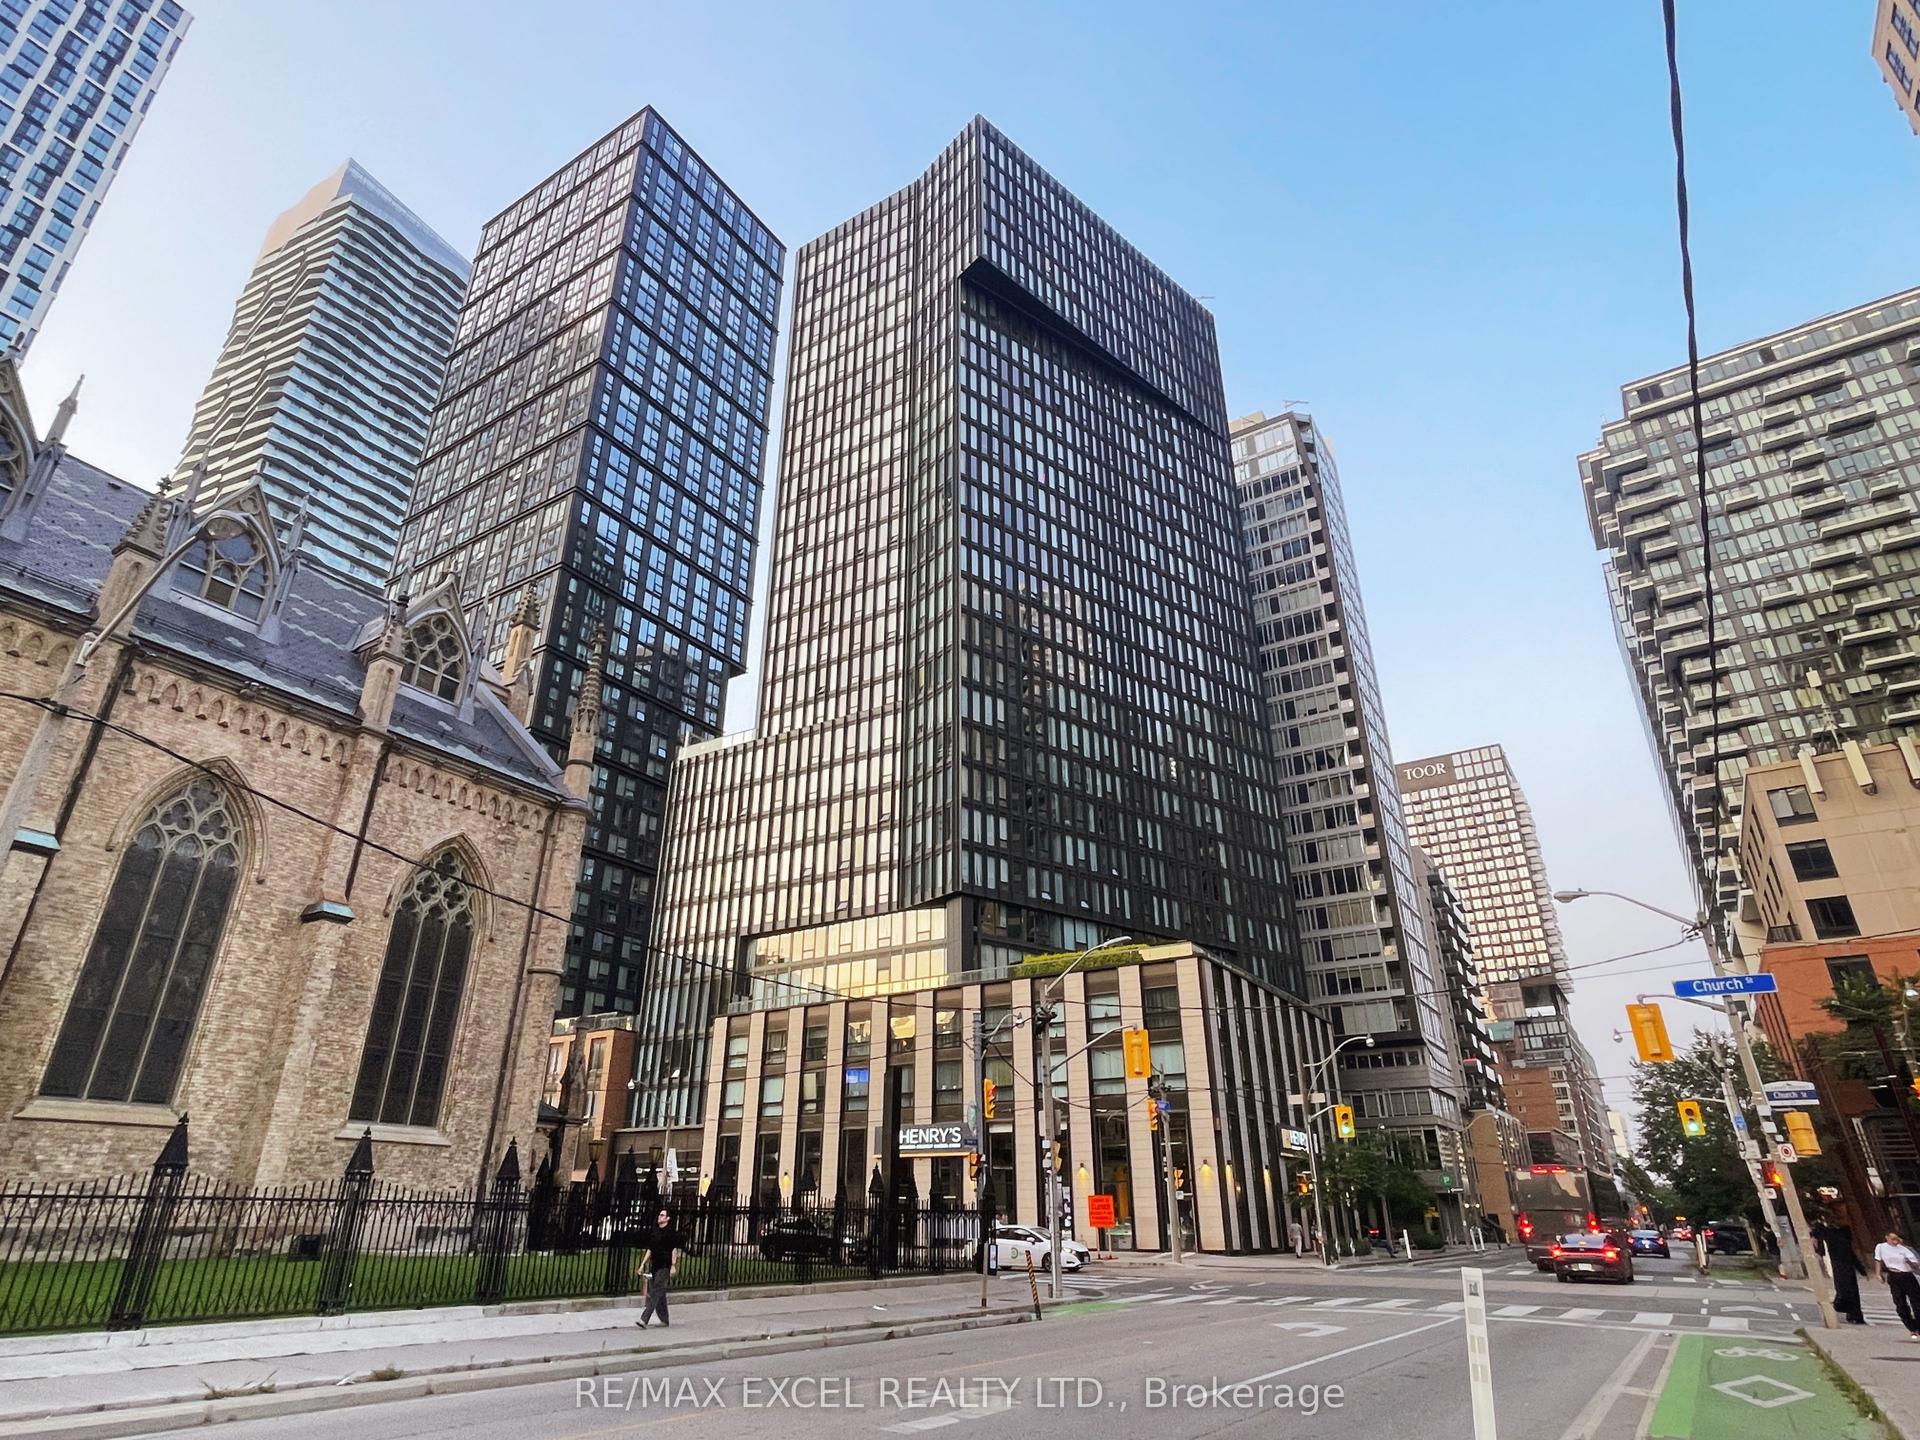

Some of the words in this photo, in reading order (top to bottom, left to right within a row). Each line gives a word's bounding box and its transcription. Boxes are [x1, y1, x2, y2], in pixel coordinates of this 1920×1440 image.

[1403, 763, 1446, 780] TOOR
[1692, 978, 1744, 993] Church
[899, 1126, 962, 1144] HENRY'S
